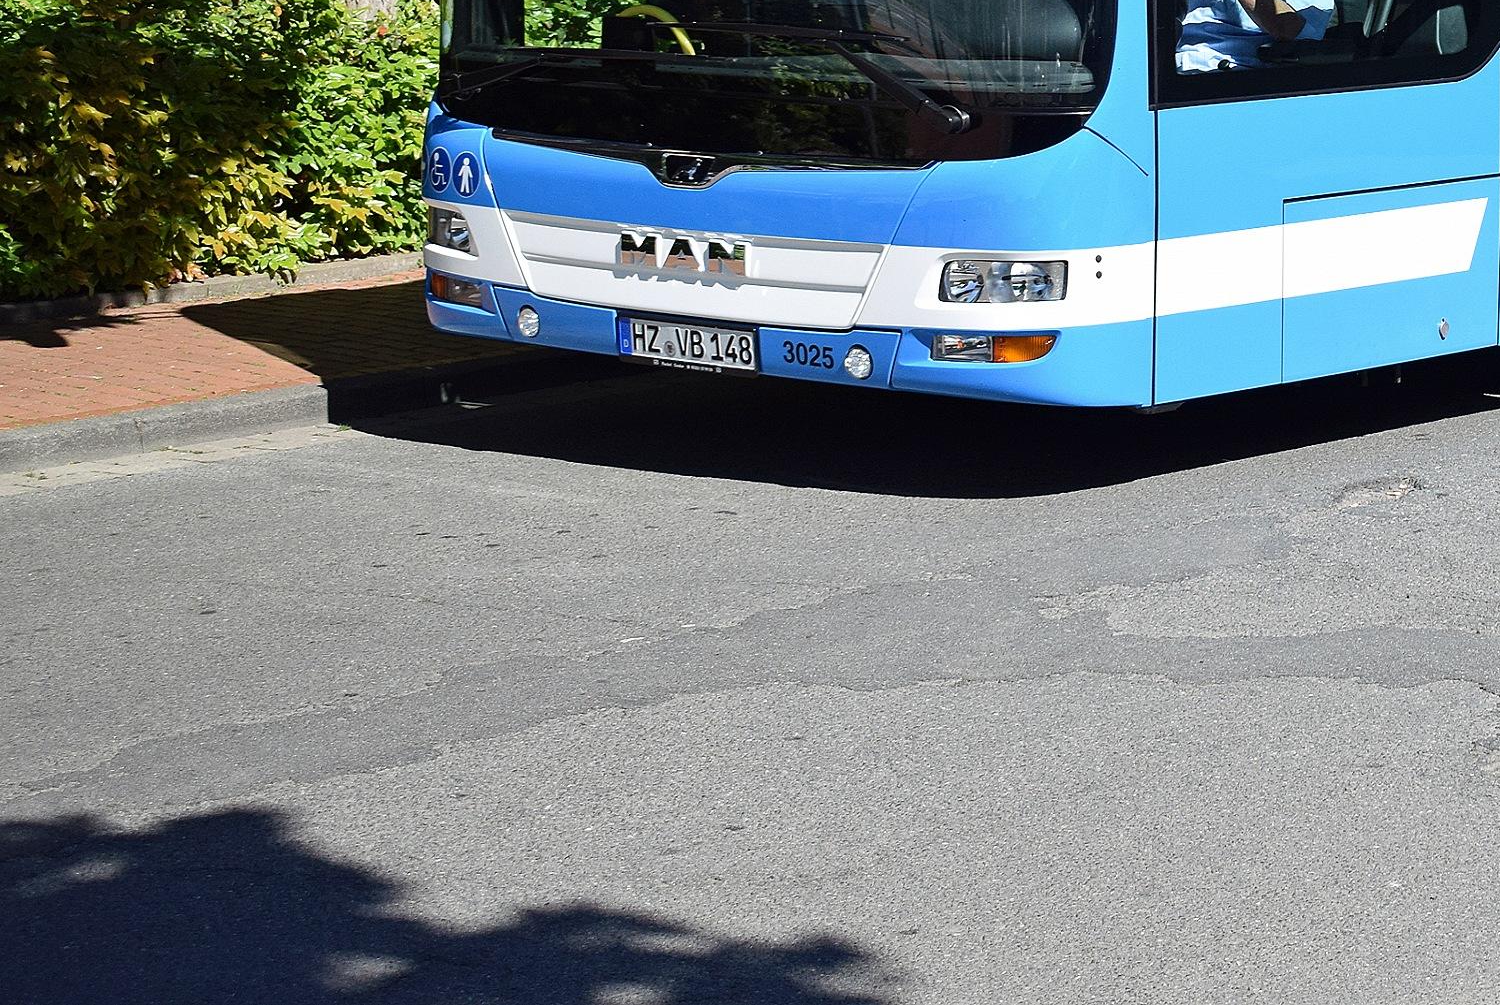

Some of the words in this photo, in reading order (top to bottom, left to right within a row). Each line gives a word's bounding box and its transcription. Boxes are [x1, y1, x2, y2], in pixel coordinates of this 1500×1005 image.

[619, 230, 750, 277] MAN
[632, 323, 661, 353] HZ
[675, 328, 705, 358] VB
[710, 333, 753, 365] 148
[783, 340, 835, 369] 3025
